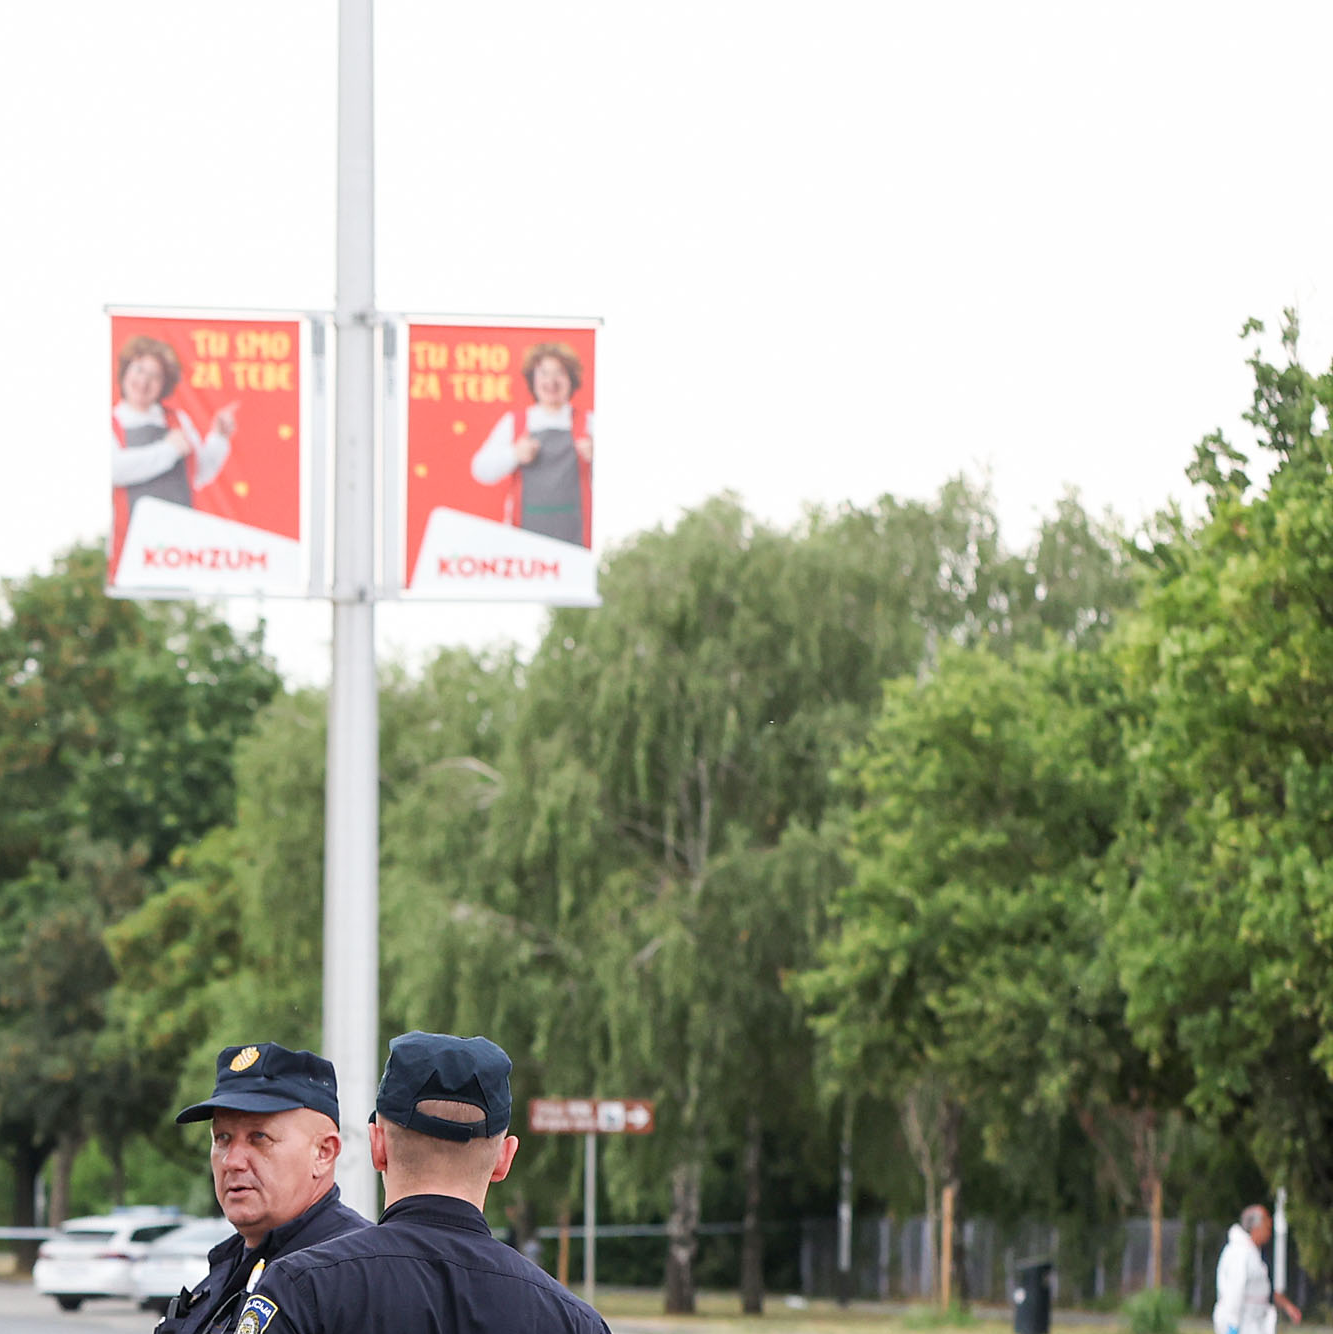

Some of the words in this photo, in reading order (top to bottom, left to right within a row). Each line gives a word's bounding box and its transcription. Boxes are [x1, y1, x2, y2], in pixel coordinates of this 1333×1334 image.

[191, 328, 230, 359] TU
[234, 329, 291, 361] SMO
[411, 340, 449, 371] TU
[454, 342, 510, 373] SMO
[190, 360, 223, 391] ZA
[230, 361, 294, 392] TEBE
[410, 372, 442, 402] ZA
[448, 373, 513, 403] TEBE
[142, 546, 270, 572] KONZUM
[436, 555, 561, 580] KONZUM
[242, 1299, 272, 1318] LICIJA
